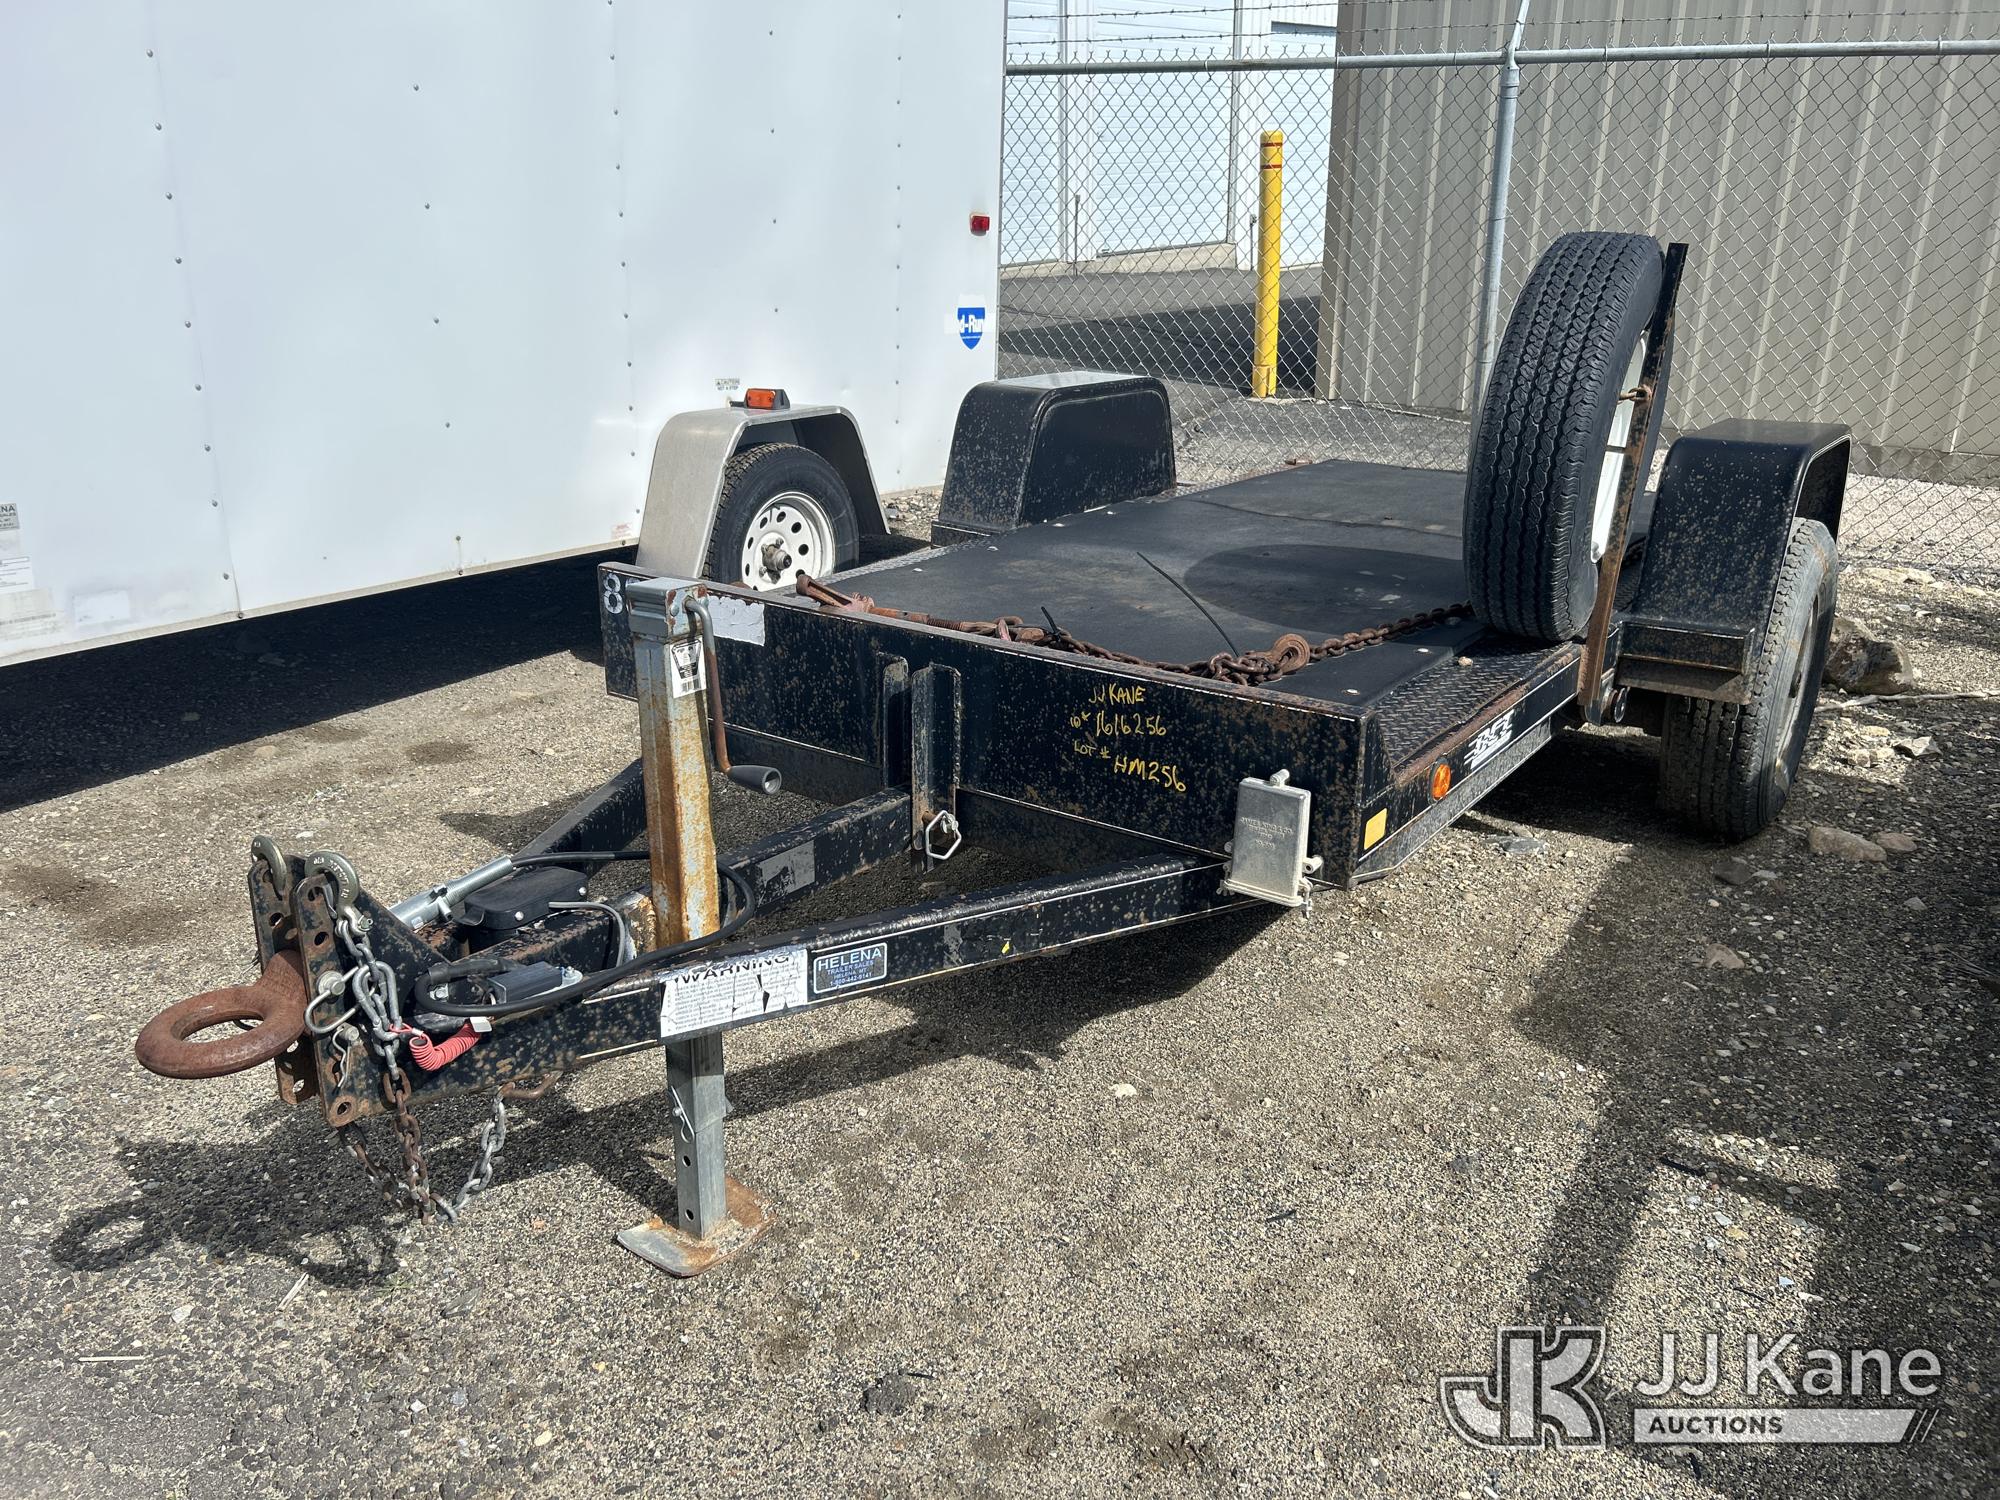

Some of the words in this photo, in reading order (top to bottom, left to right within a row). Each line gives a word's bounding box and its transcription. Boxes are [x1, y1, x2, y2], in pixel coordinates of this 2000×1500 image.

[0, 505, 15, 513] NA
[1109, 683, 1146, 706] KANE
[1096, 710, 1167, 737] 1616256
[1074, 740, 1097, 757] LOT
[1114, 755, 1187, 792] HM256
[818, 947, 882, 972] HELENA
[827, 965, 853, 975] TRAILER
[855, 960, 874, 969] SALES
